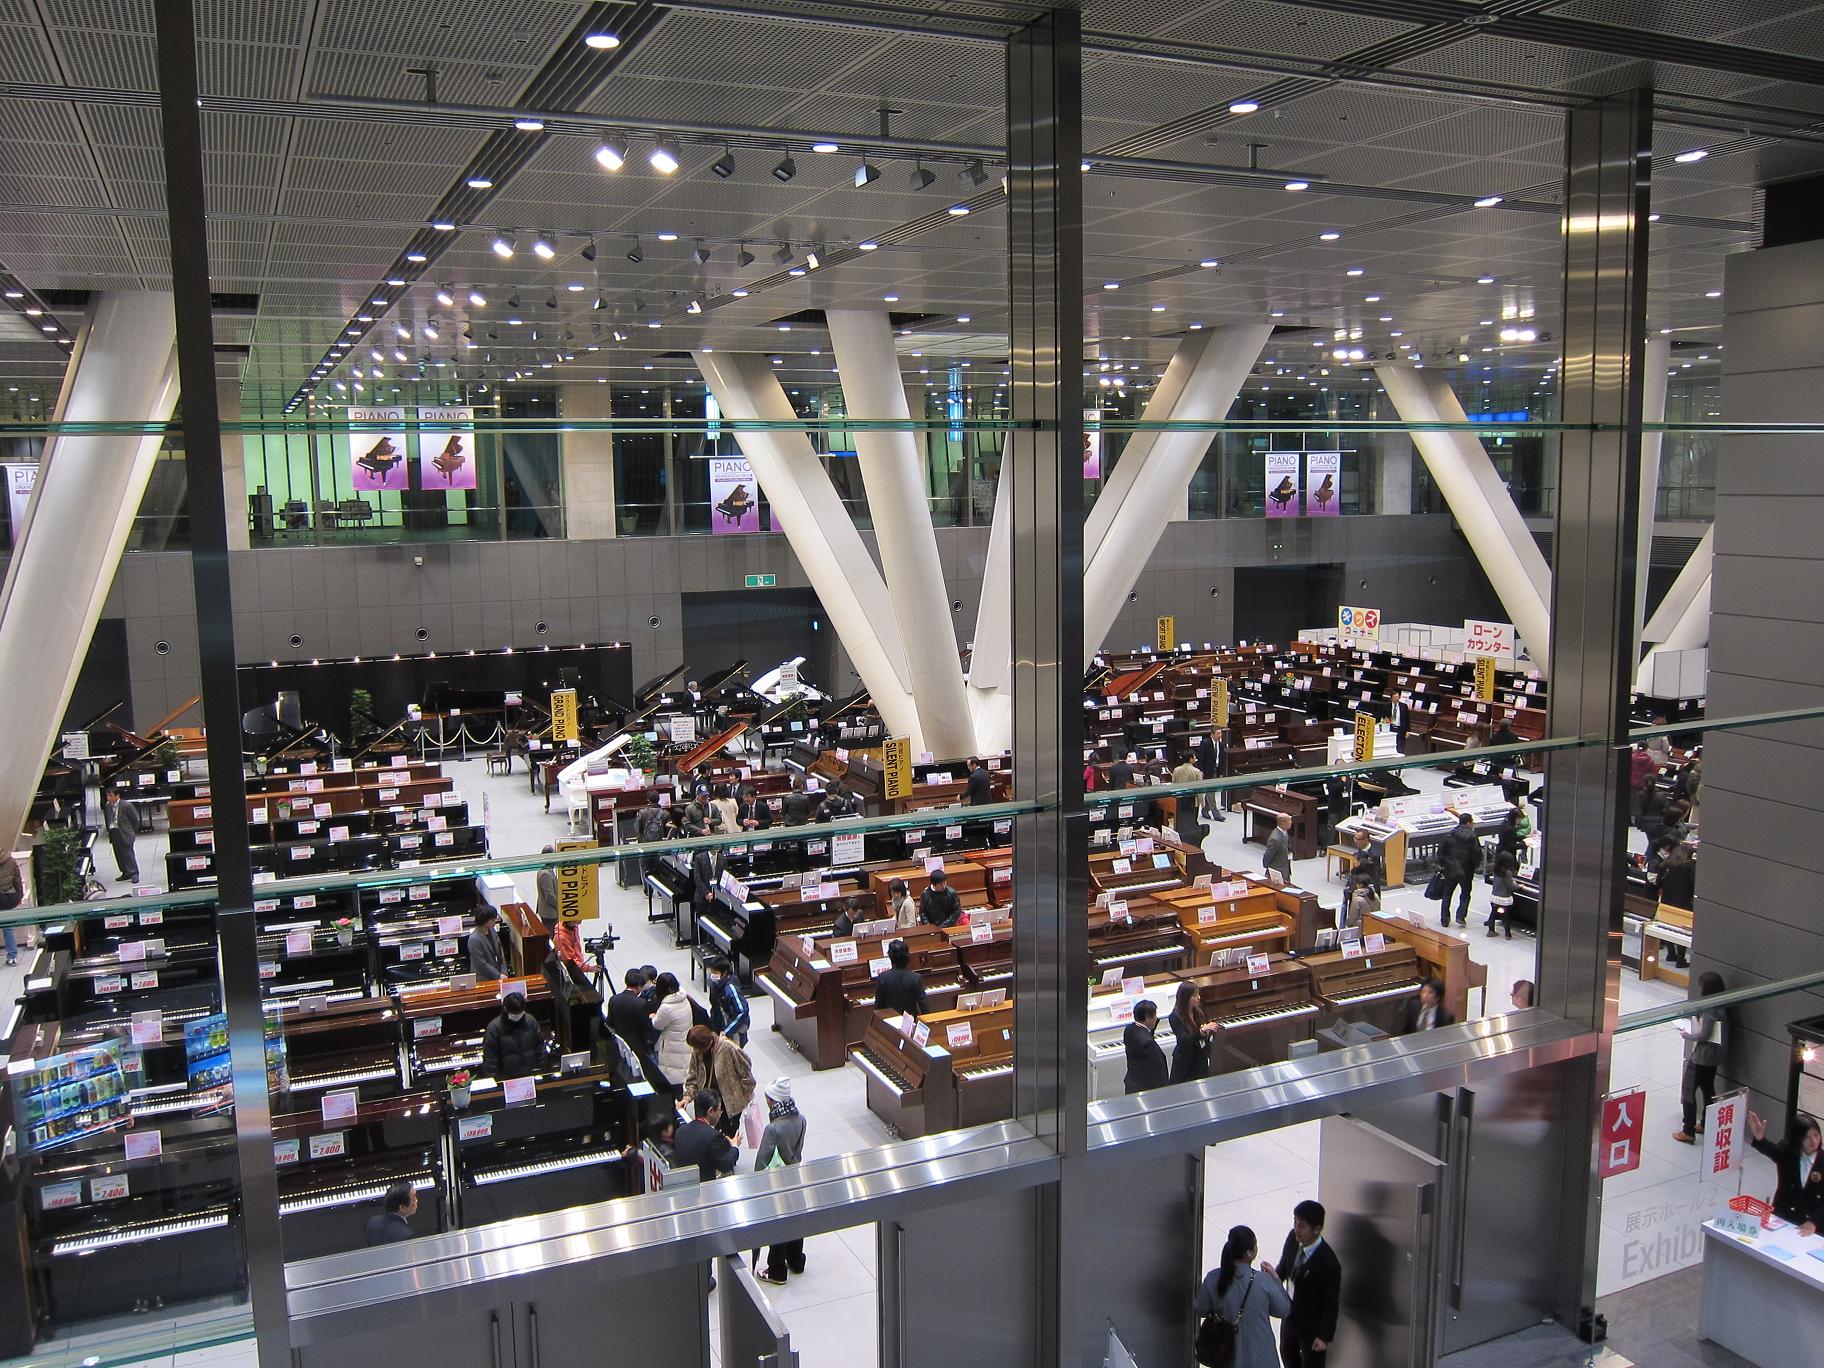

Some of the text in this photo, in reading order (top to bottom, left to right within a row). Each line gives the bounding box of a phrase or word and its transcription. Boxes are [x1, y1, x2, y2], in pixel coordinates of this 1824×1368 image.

[15, 471, 38, 482] PIA
[714, 461, 751, 472] PIANO
[1268, 456, 1296, 466] PIANO
[1310, 455, 1337, 465] PIANO
[1467, 638, 1510, 652] カウンター
[1473, 624, 1503, 639] ローン
[1476, 659, 1485, 699] SILENT PIANO
[553, 694, 566, 739] GRAND PIANO
[1211, 681, 1219, 724] NEW PIANO
[885, 742, 899, 797] SILENT PIANO
[561, 881, 579, 918] PIANO
[1609, 1102, 1633, 1168] 入口
[1713, 1104, 1734, 1173] 領収証
[1625, 1187, 1718, 1233] 展示ホール 2
